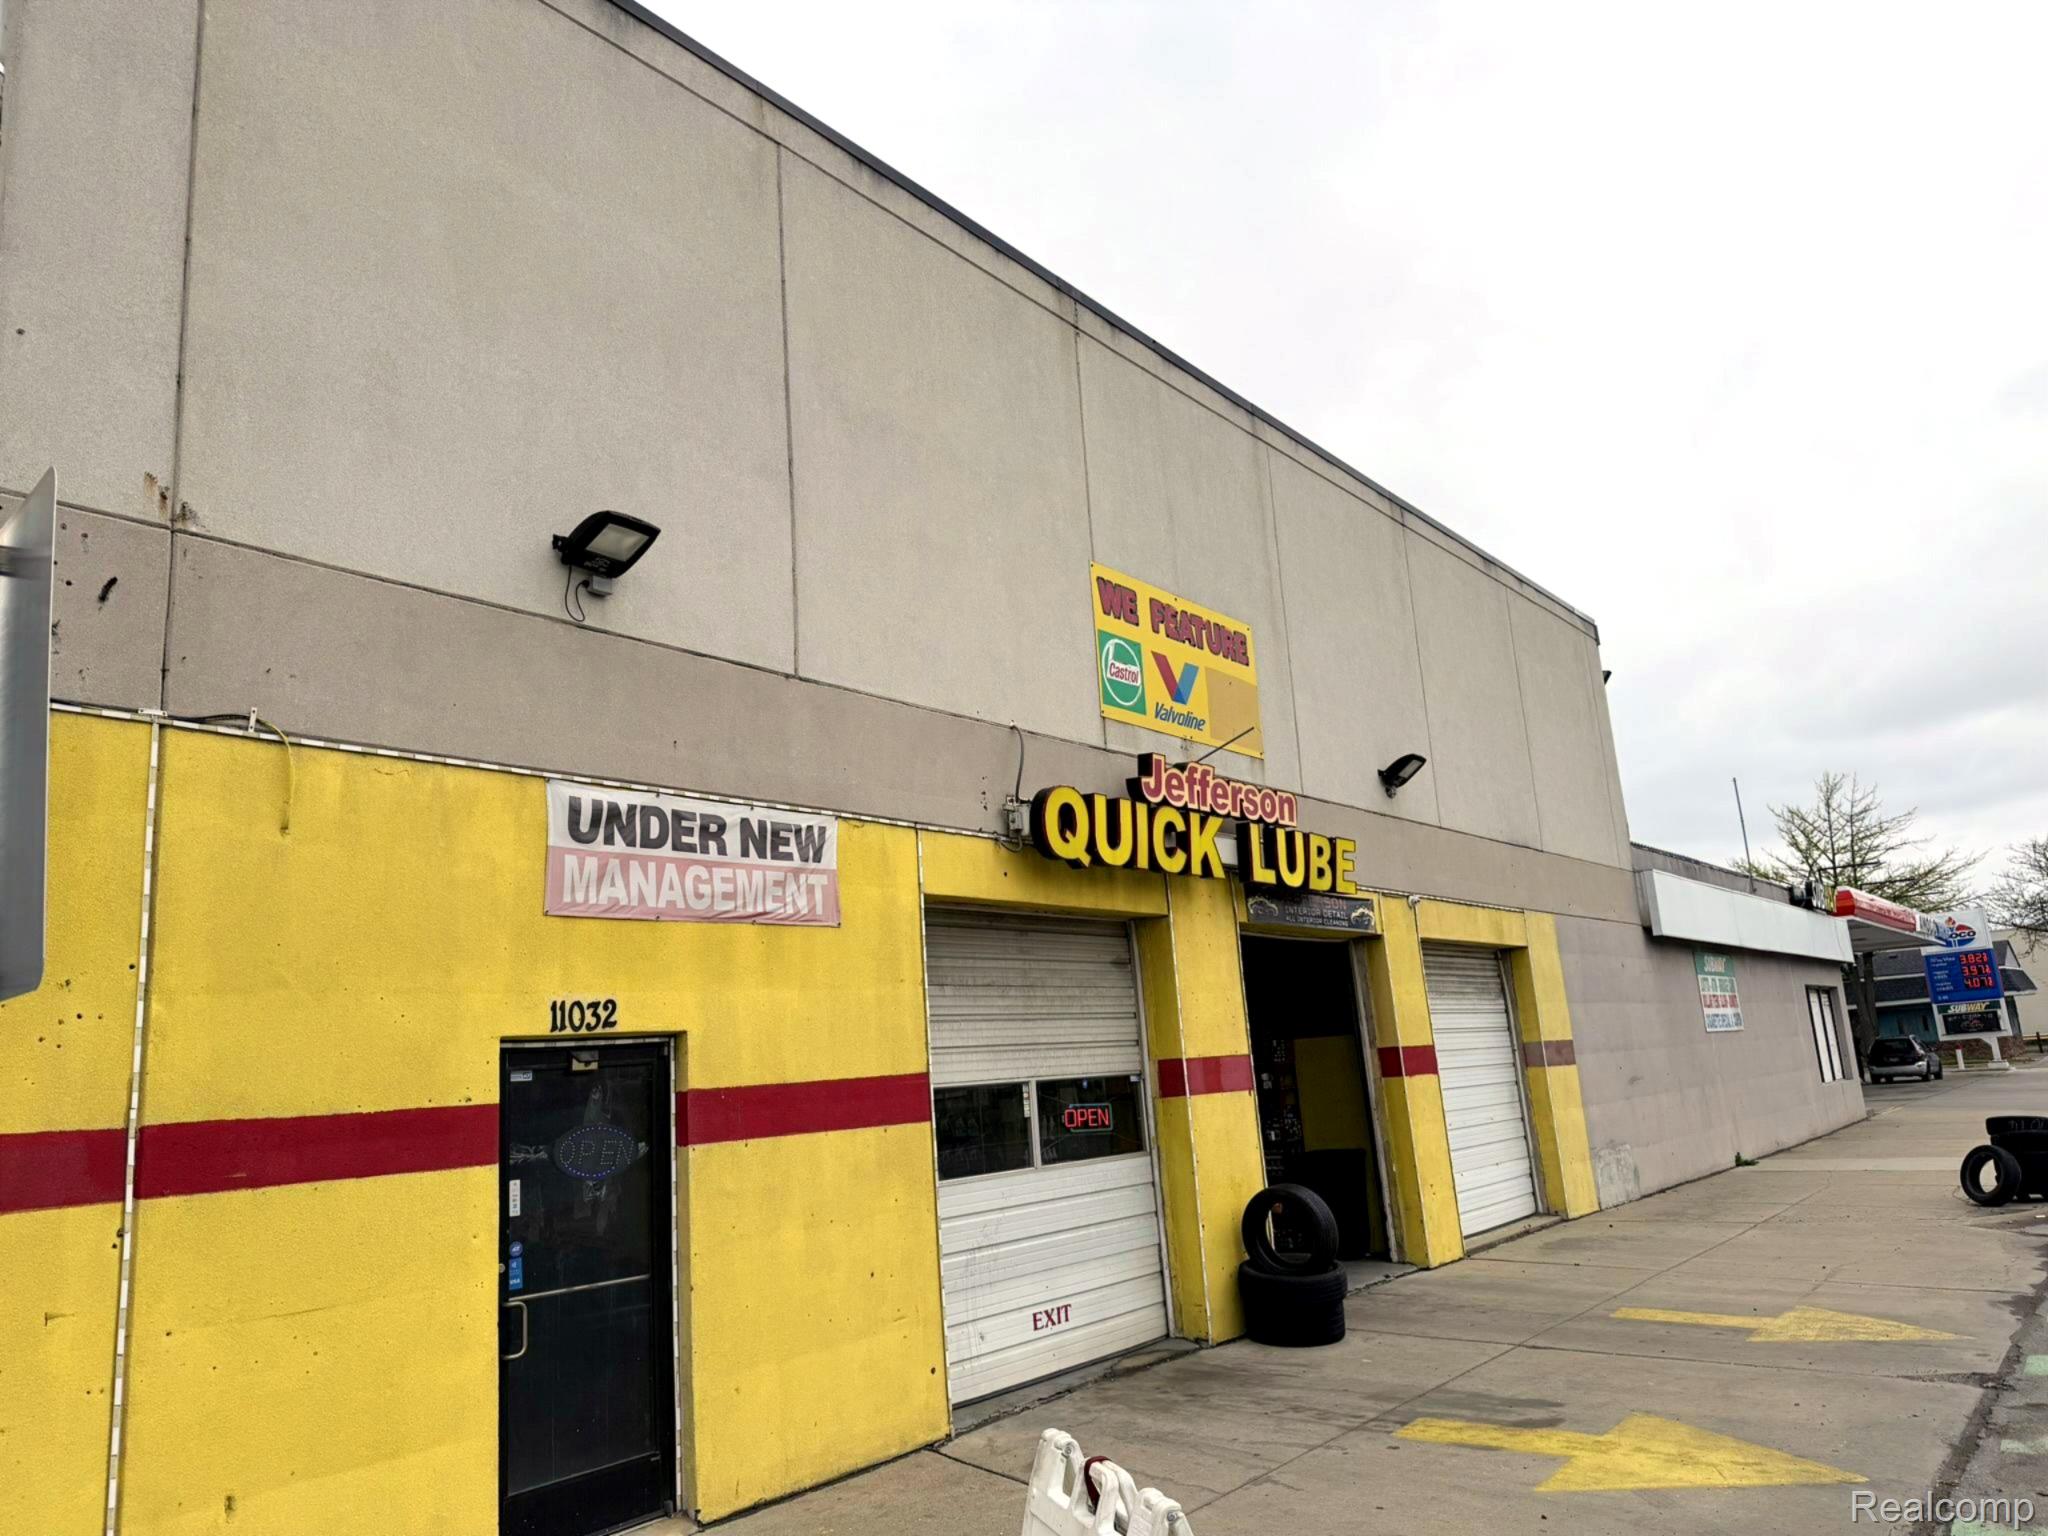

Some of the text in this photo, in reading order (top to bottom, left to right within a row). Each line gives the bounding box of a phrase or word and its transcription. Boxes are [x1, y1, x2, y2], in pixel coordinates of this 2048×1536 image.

[1097, 576, 1249, 667] WE FEATURE
[1109, 659, 1139, 685] Castrol
[1155, 702, 1206, 731] Valvoline
[1142, 753, 1297, 826] Jefferson
[568, 795, 827, 863] UNDER NEW
[1045, 785, 1357, 894] QUICK LUBE
[563, 854, 828, 916] MANAGEMENT
[1322, 908, 1348, 919] DETAIL
[1950, 930, 1976, 939] OCO
[550, 999, 617, 1033] 11032
[1948, 1002, 1989, 1014] SUBWAY
[1064, 1107, 1110, 1128] OPEN
[560, 1140, 634, 1165] OPEN
[1032, 1303, 1072, 1331] EXIT
